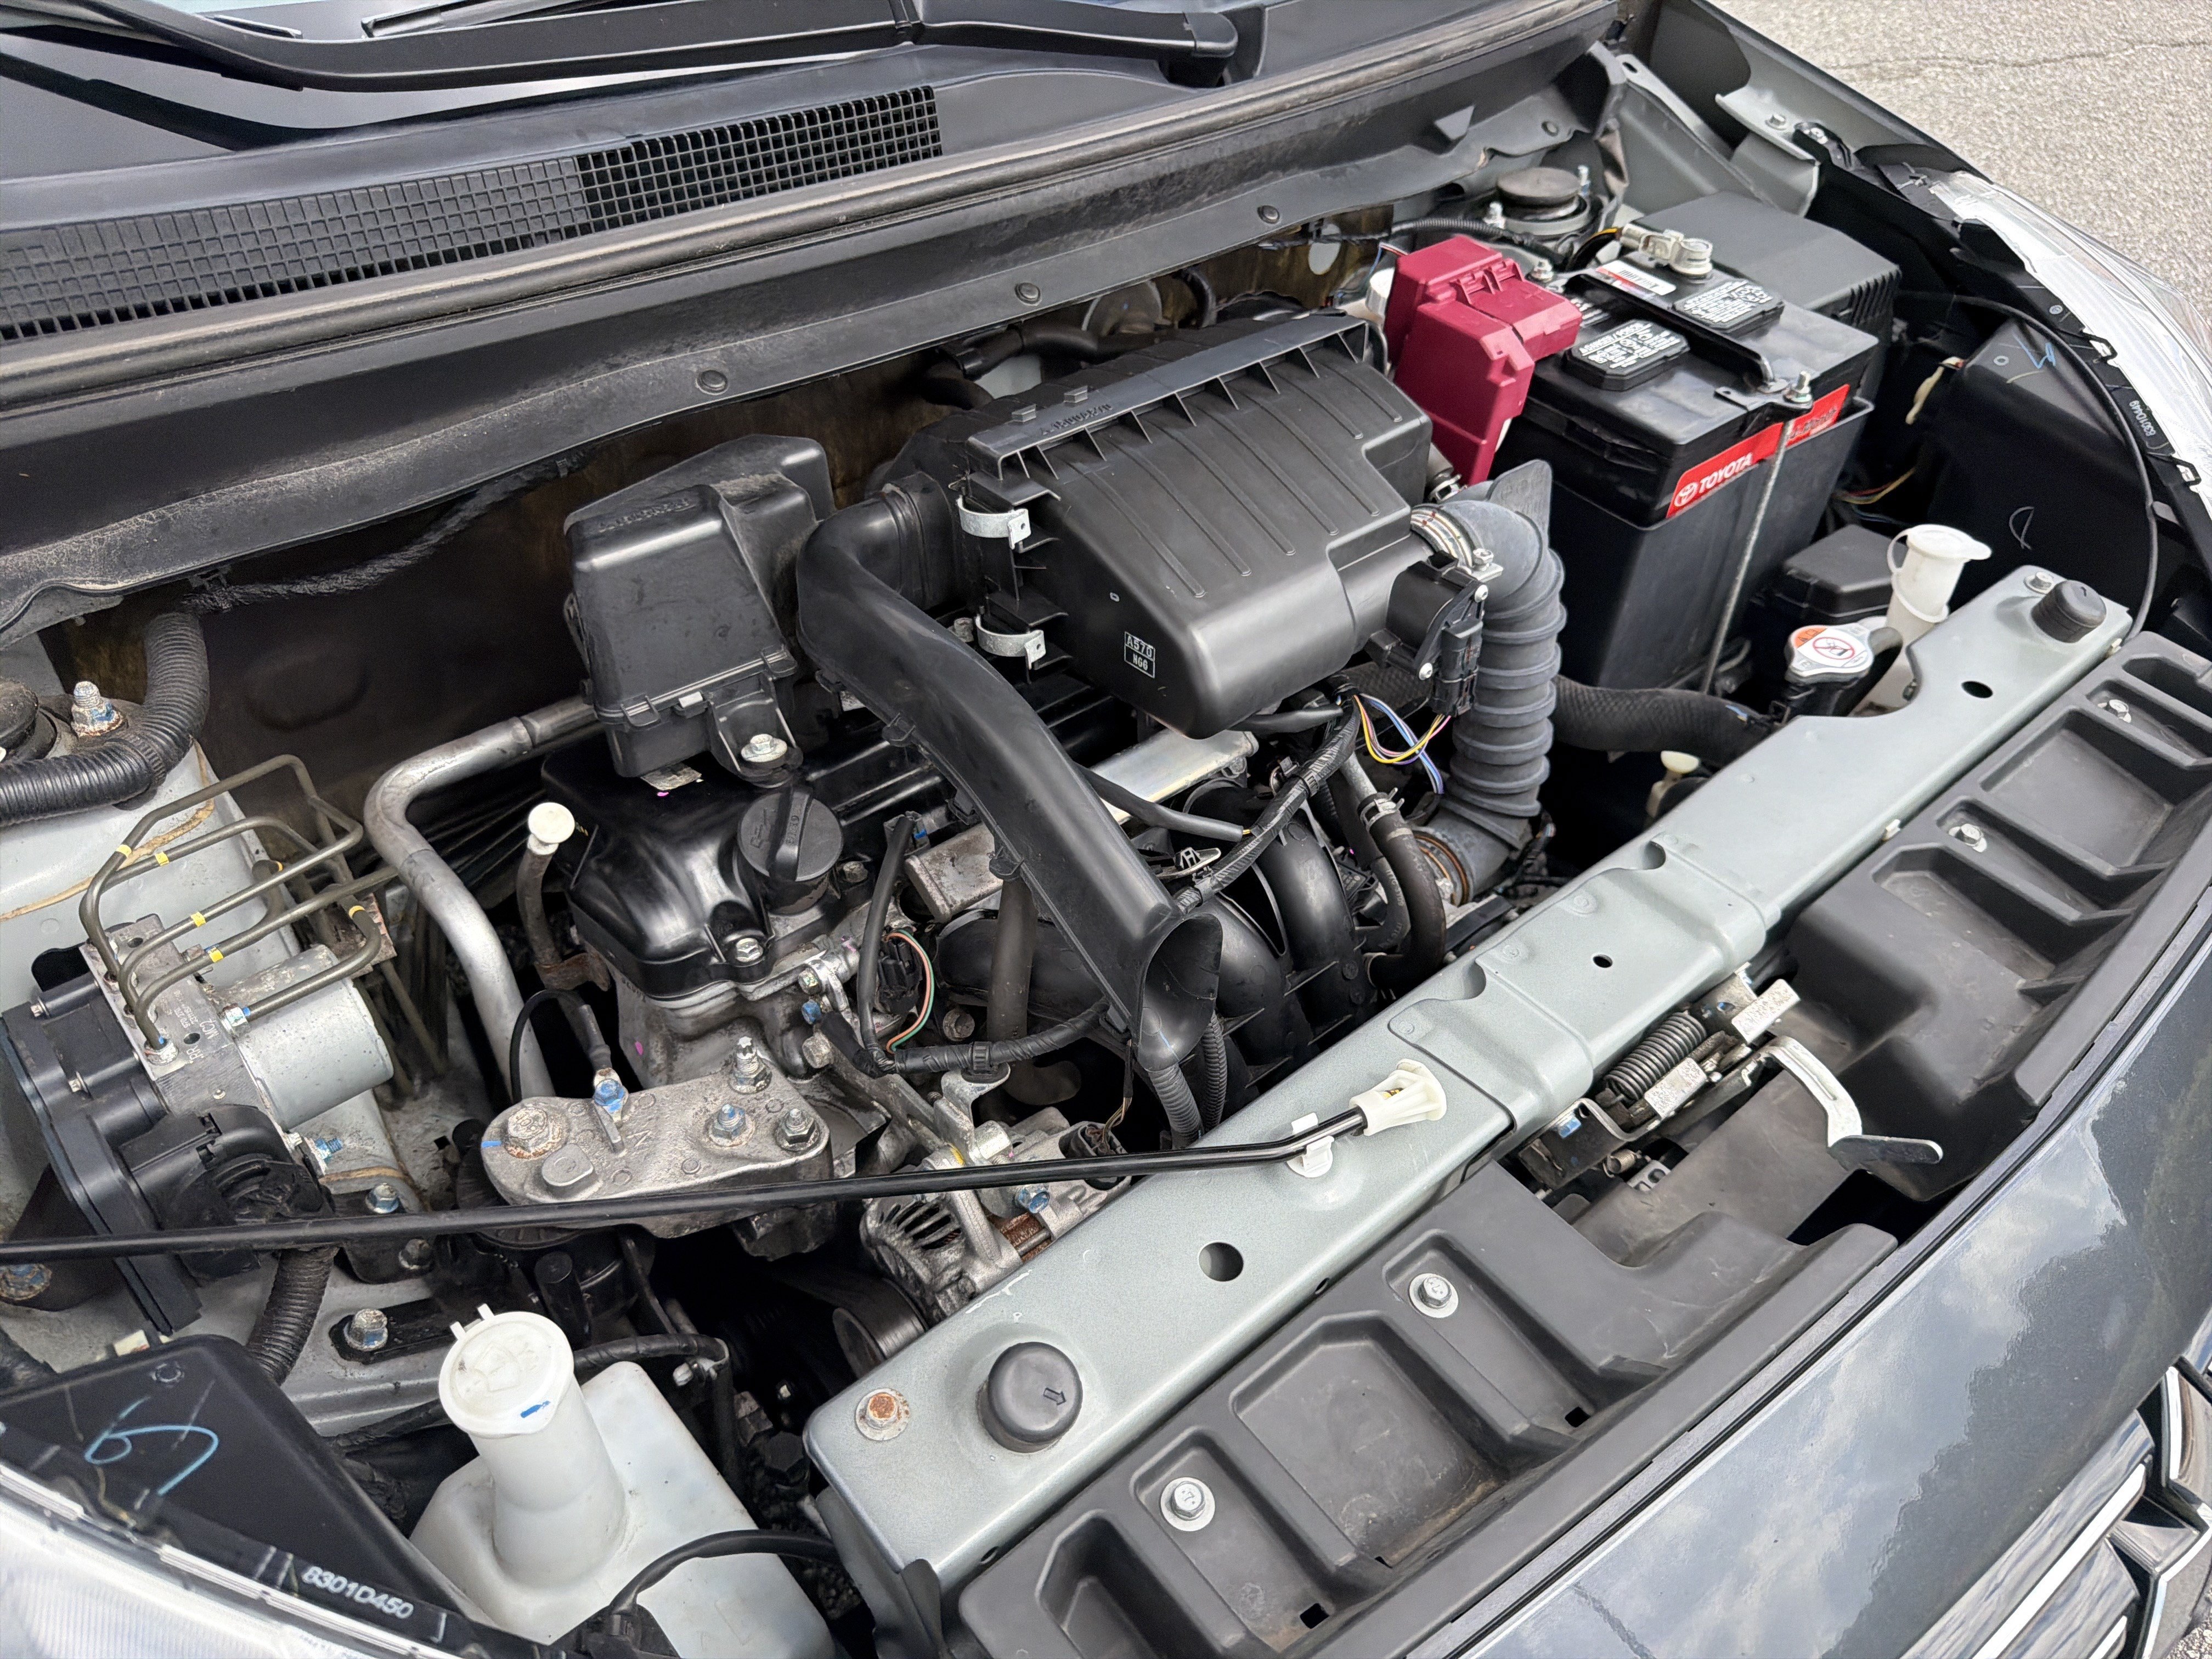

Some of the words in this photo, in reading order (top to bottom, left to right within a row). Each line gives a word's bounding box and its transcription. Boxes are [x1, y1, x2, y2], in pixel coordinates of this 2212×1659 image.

[1700, 452, 1752, 493] TOYOTA
[1127, 635, 1152, 658] A570
[302, 1566, 414, 1619] 8301D450
